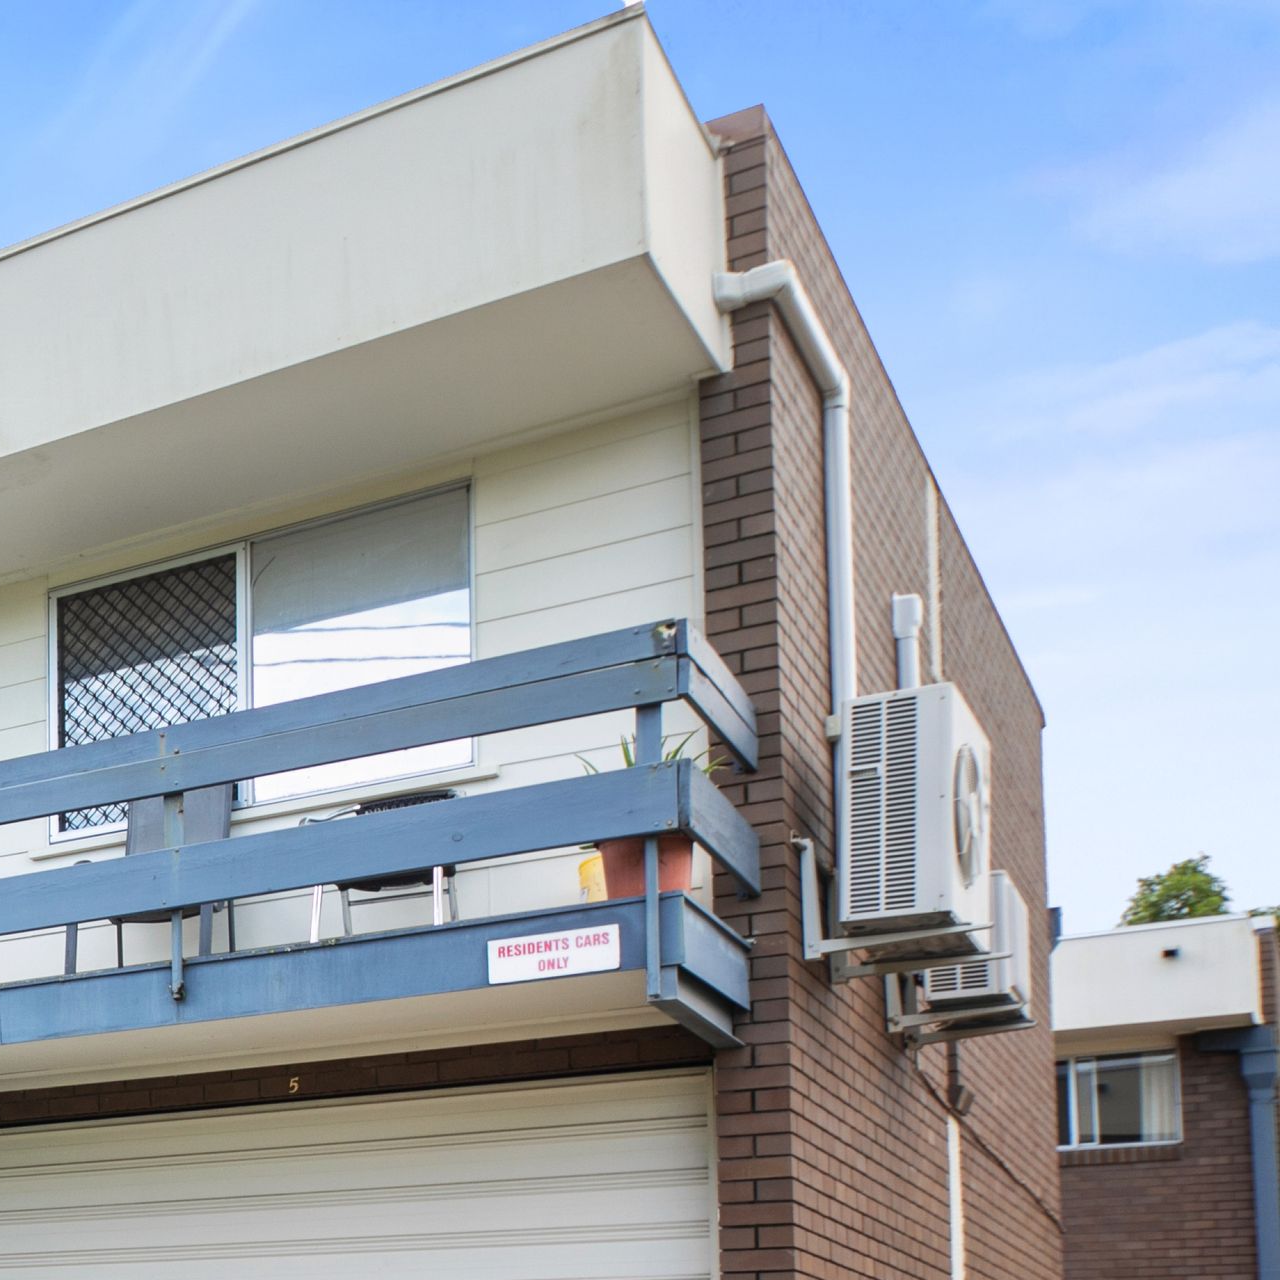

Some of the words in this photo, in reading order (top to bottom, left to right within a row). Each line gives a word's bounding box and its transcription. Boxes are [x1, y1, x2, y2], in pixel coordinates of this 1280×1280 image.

[497, 938, 570, 958] RESIDENTS
[575, 931, 610, 949] CARS
[538, 956, 569, 972] ONLY
[289, 1076, 299, 1094] 5
